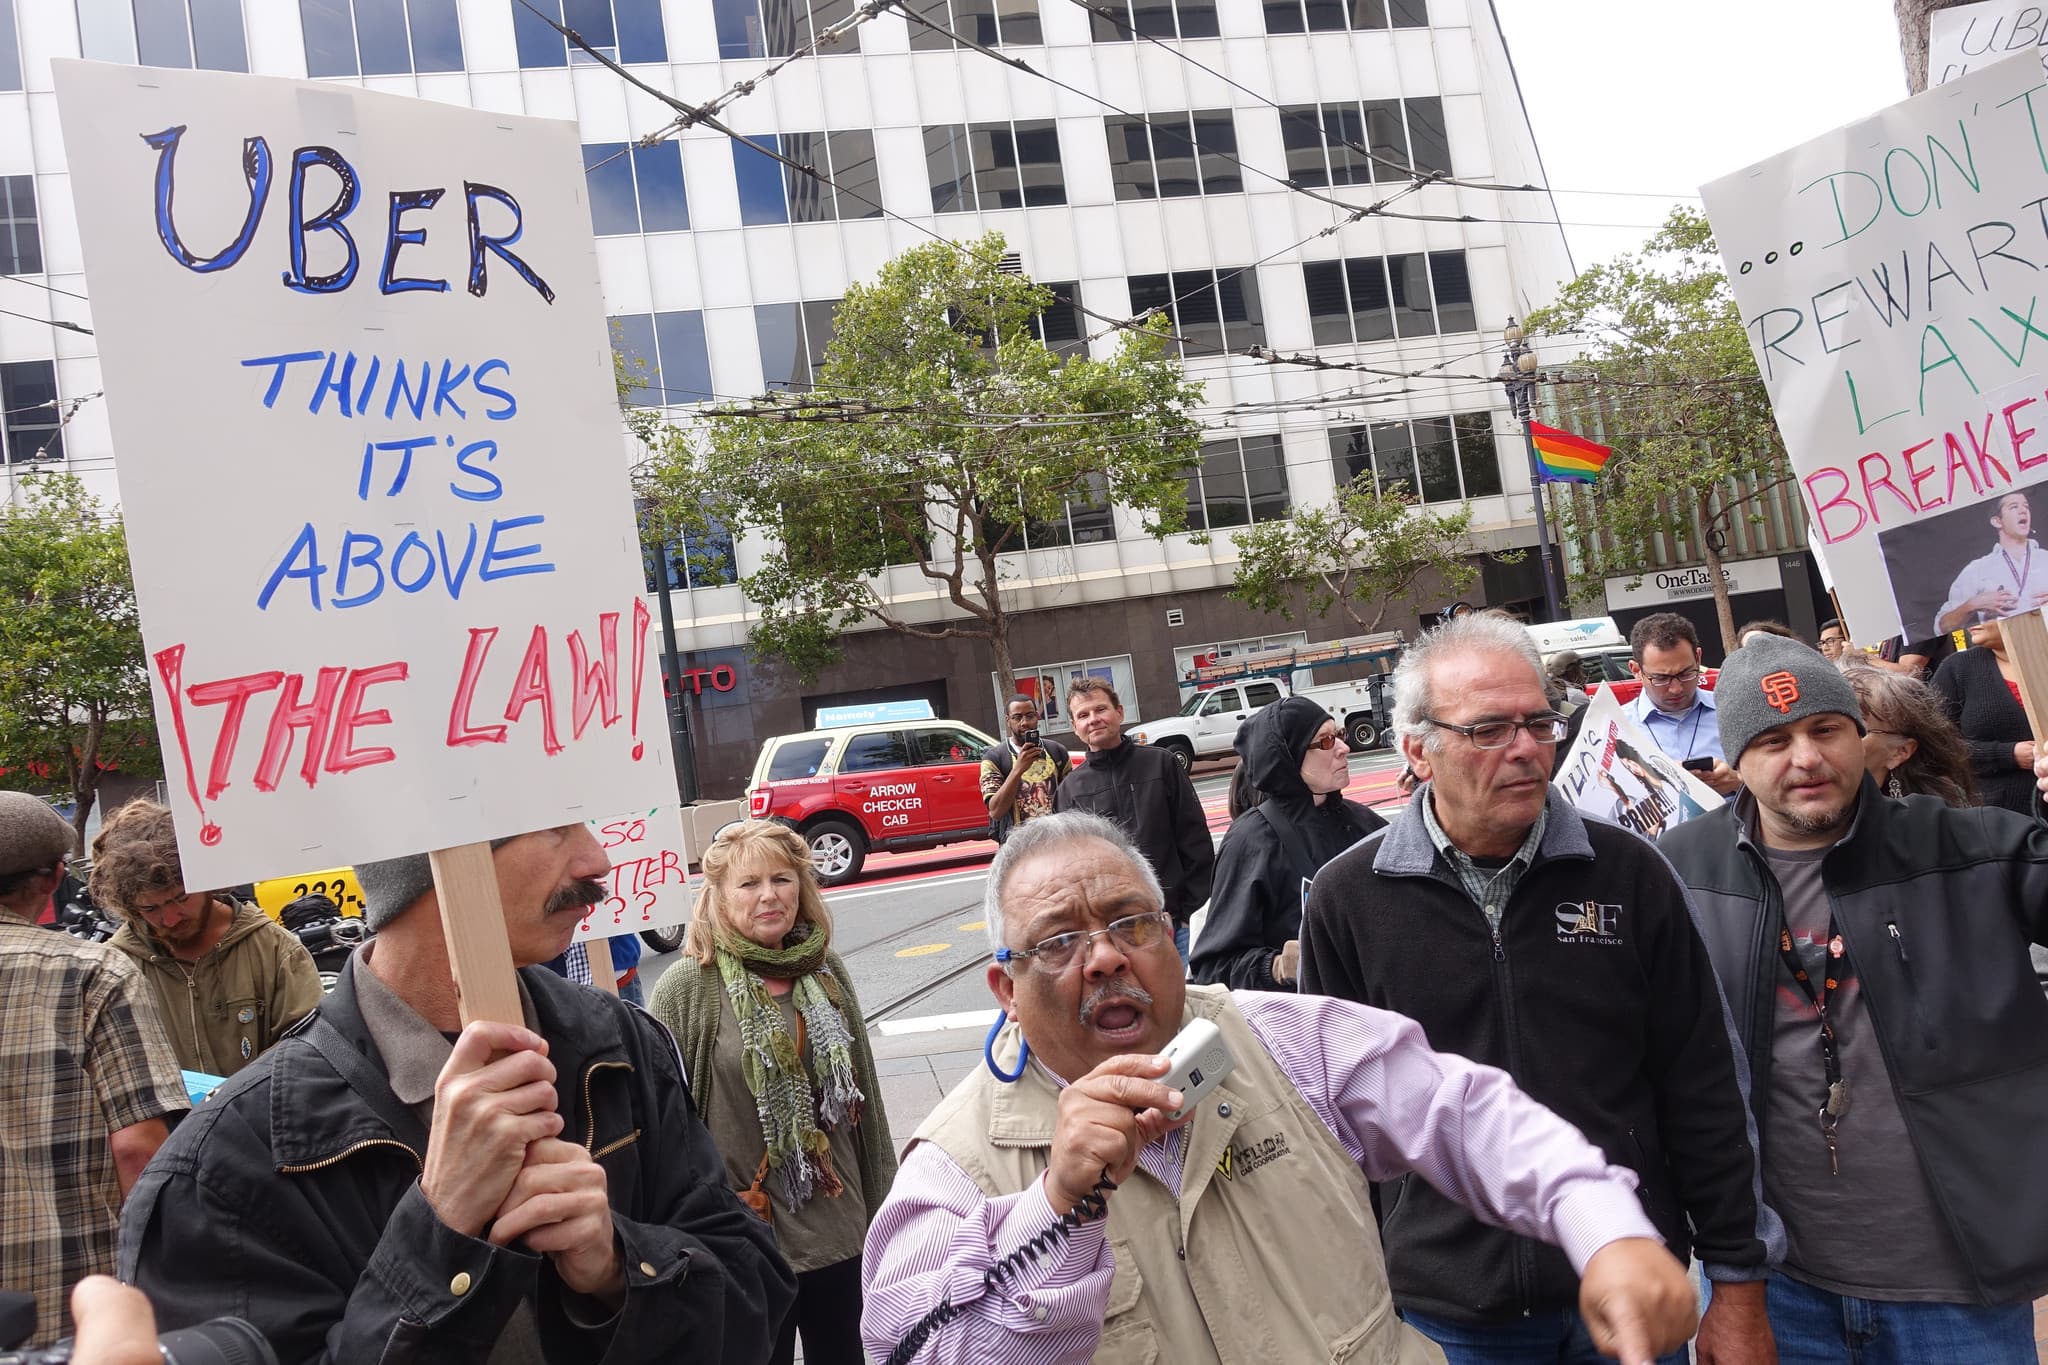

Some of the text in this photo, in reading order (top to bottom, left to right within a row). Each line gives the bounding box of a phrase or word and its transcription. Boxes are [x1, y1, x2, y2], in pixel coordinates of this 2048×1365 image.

[1961, 6, 2048, 56] UB
[138, 124, 556, 305] UBER
[241, 348, 517, 422] THINKS
[357, 434, 503, 501] IT'S
[1802, 388, 2048, 544] BREAKE
[256, 515, 556, 612] ABOVE
[1655, 569, 1730, 590] OneTae
[447, 596, 651, 761] LAW!
[862, 798, 922, 814] CHECKER
[869, 783, 916, 798] ARROW
[882, 814, 909, 827] CAB
[597, 849, 686, 896] TTER
